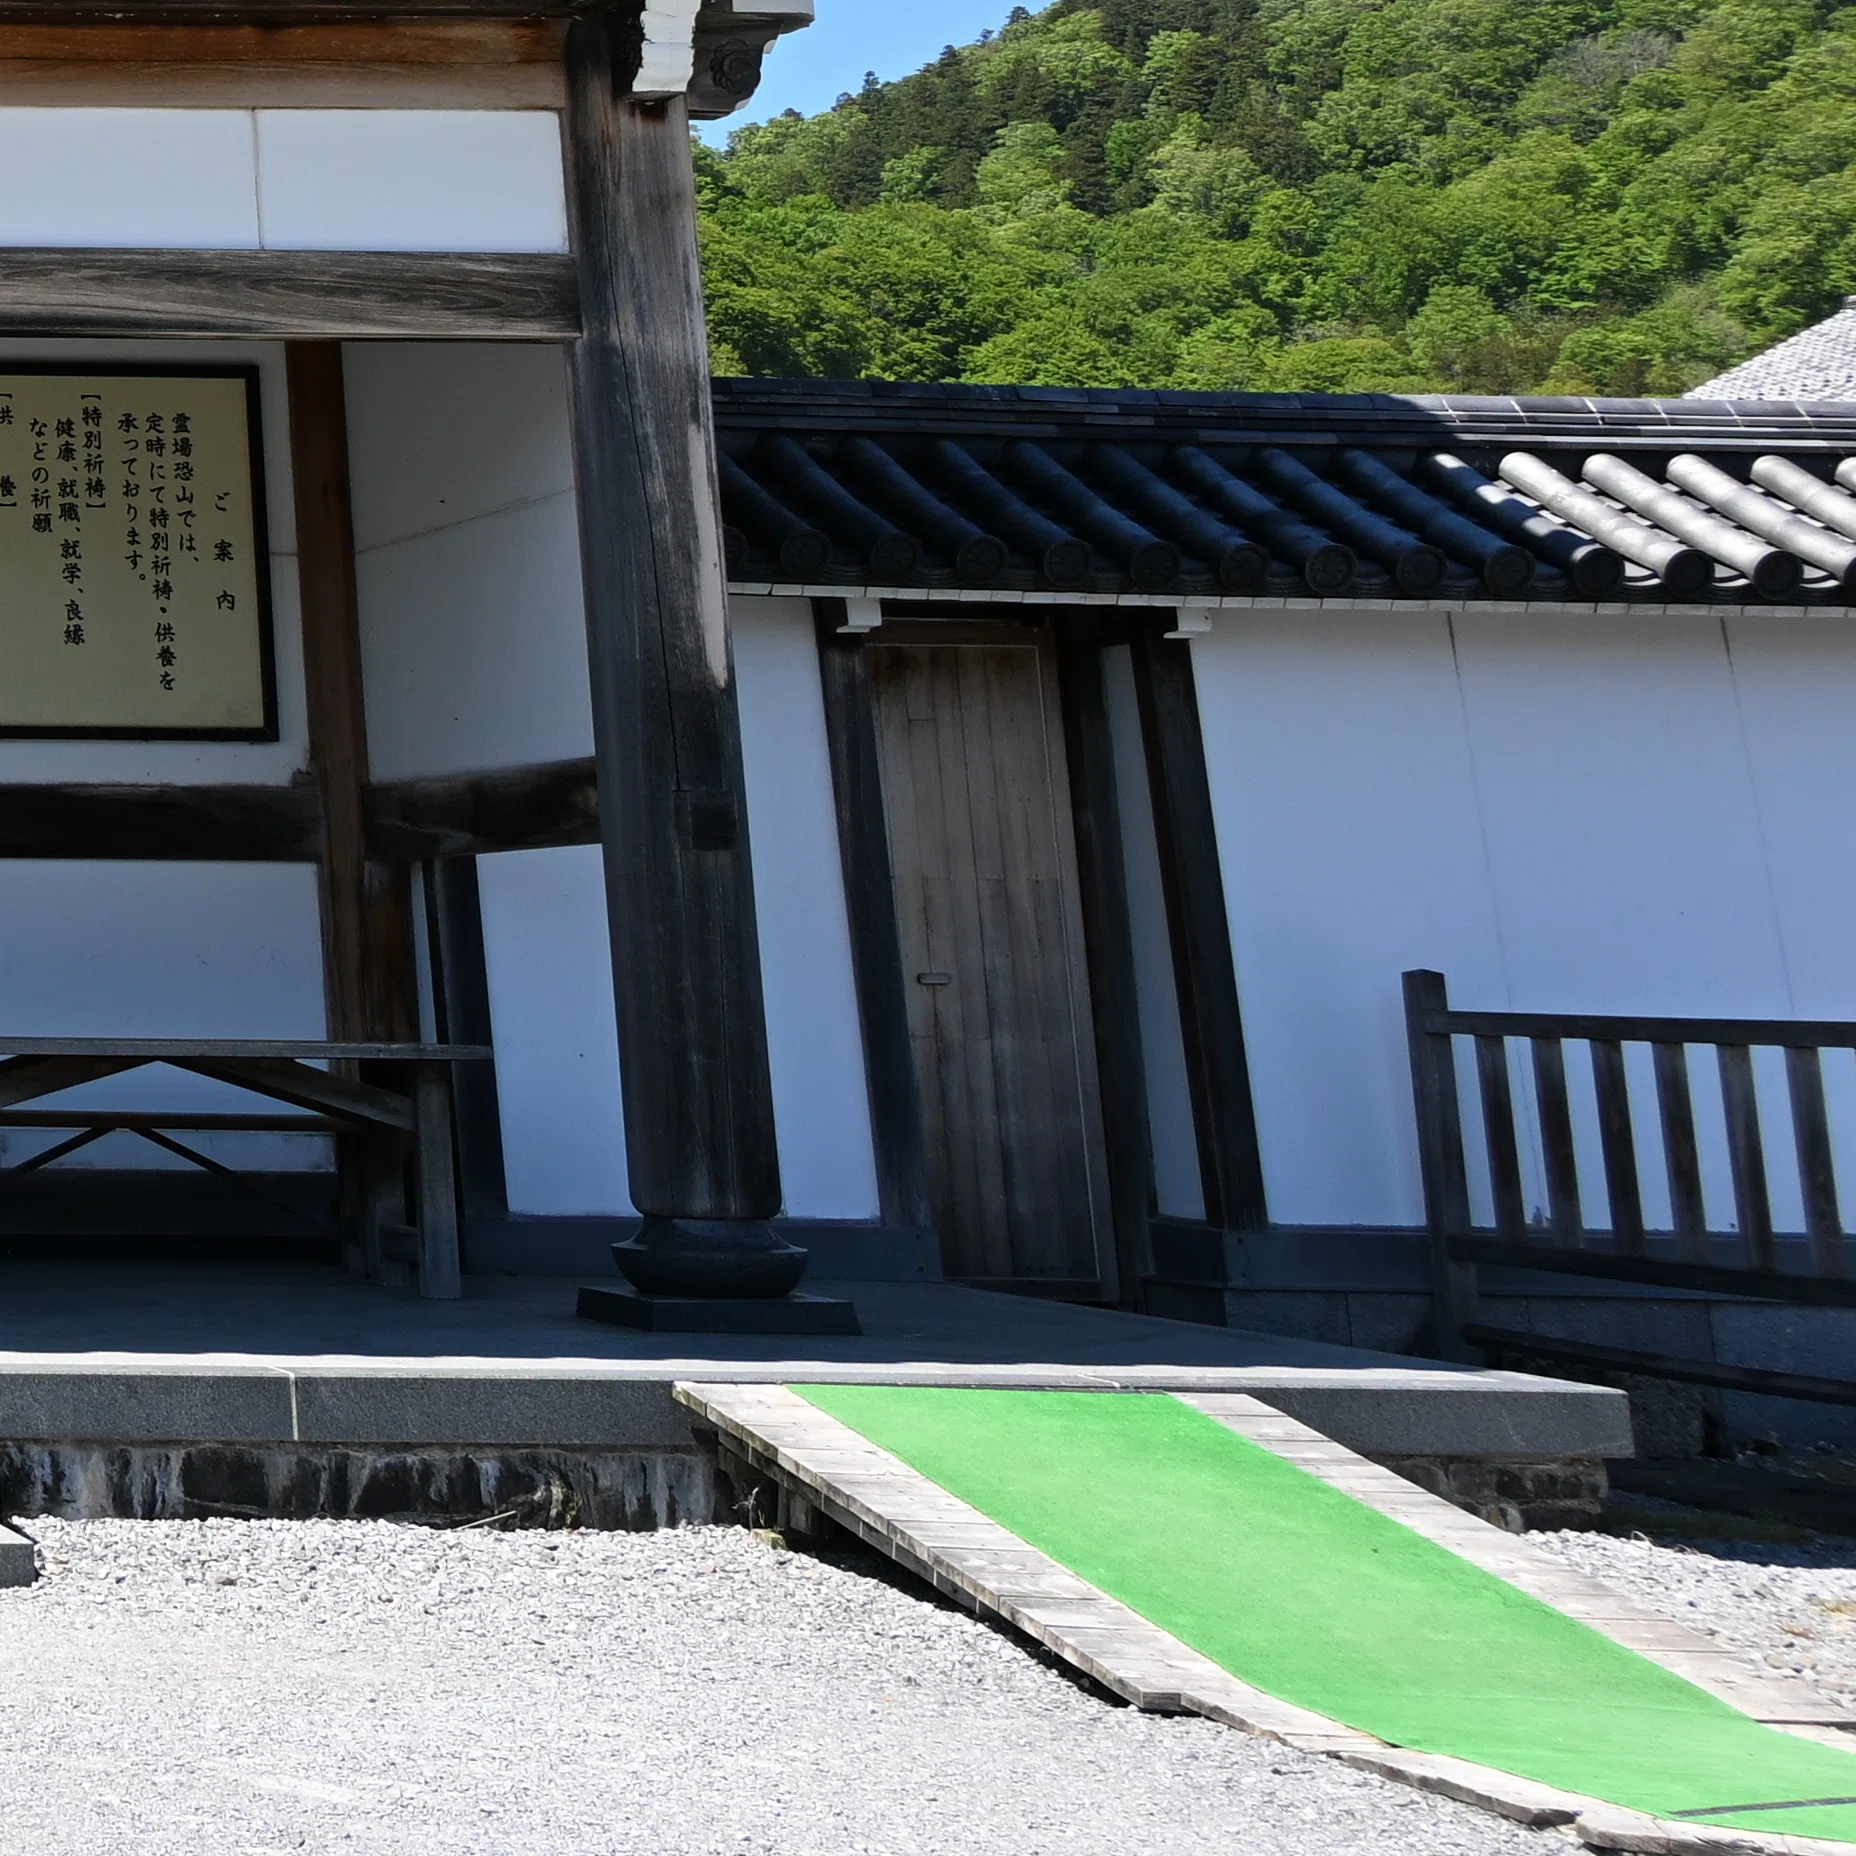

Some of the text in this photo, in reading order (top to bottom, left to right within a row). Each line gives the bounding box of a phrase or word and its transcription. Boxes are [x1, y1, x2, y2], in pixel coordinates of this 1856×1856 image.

[29, 418, 52, 533] などの祈願
[55, 418, 85, 646] 健康、就職、就学、良縁
[117, 413, 146, 581] 承っております。
[145, 412, 177, 691] 定時にて特別祈祷・供養を
[172, 413, 199, 562] 霊場恐山では、
[213, 492, 235, 611] ご案内
